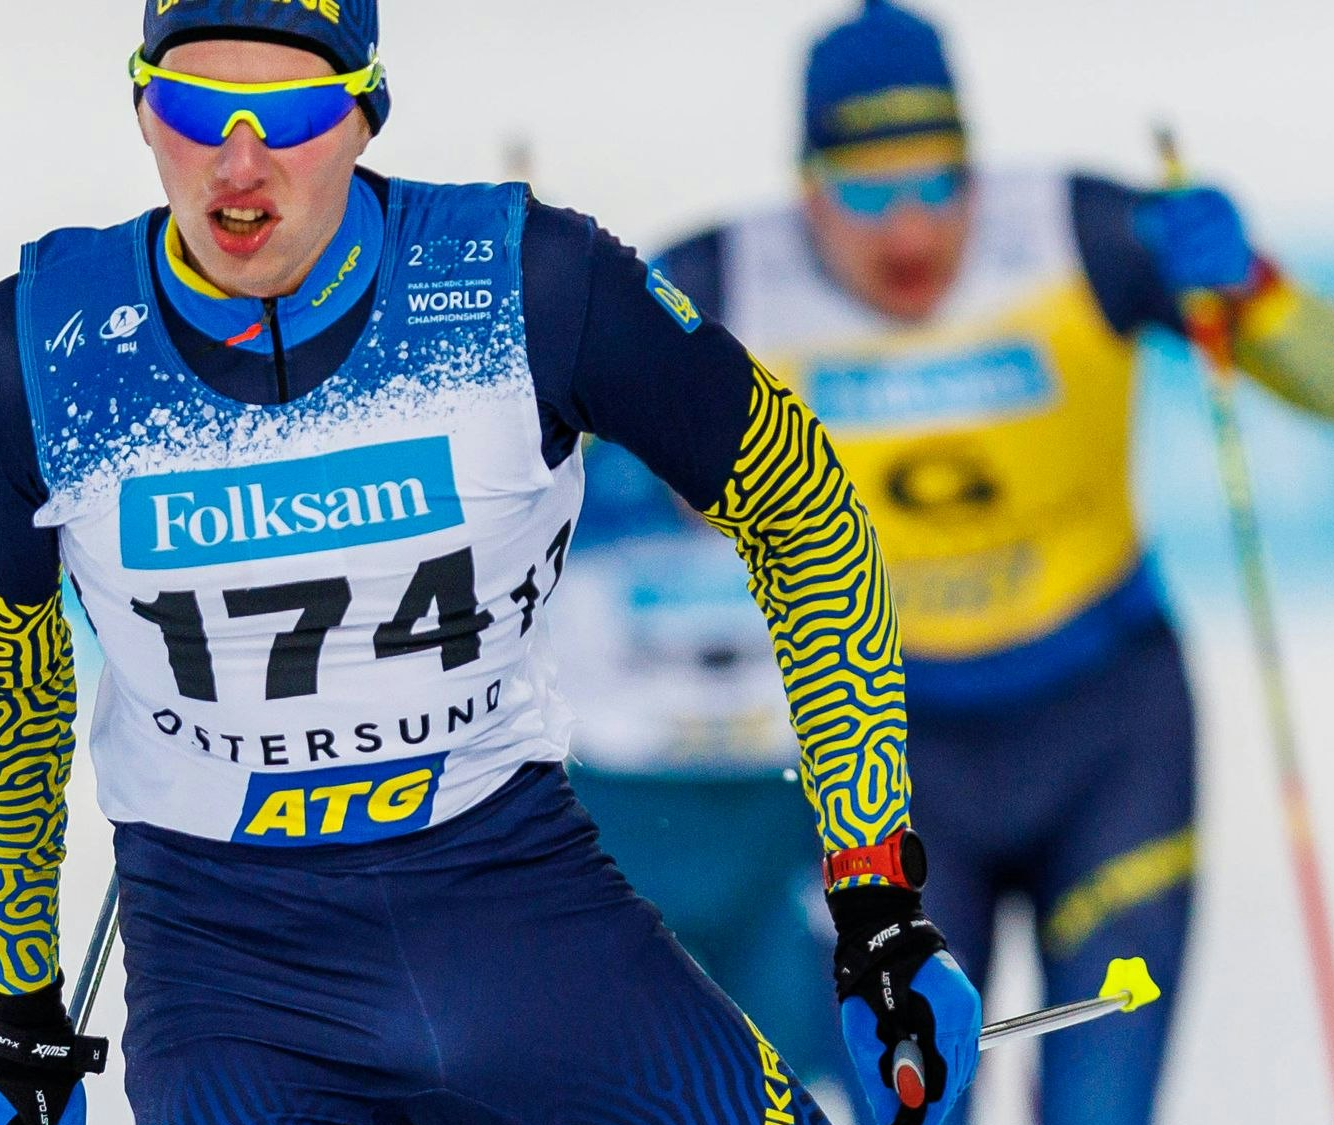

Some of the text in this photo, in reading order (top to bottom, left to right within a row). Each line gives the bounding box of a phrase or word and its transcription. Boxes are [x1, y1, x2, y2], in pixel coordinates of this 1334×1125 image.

[407, 277, 493, 290] PARA NORDIC SKIING
[407, 289, 493, 312] WORLD
[407, 311, 492, 325] CHAMPIONSHIPS
[116, 341, 138, 354] IBU
[149, 475, 432, 553] Folksam
[129, 546, 495, 702] 174
[243, 767, 434, 838] ATG
[867, 923, 901, 952] swix
[31, 1043, 71, 1059] swix
[93, 1050, 100, 1060] R
